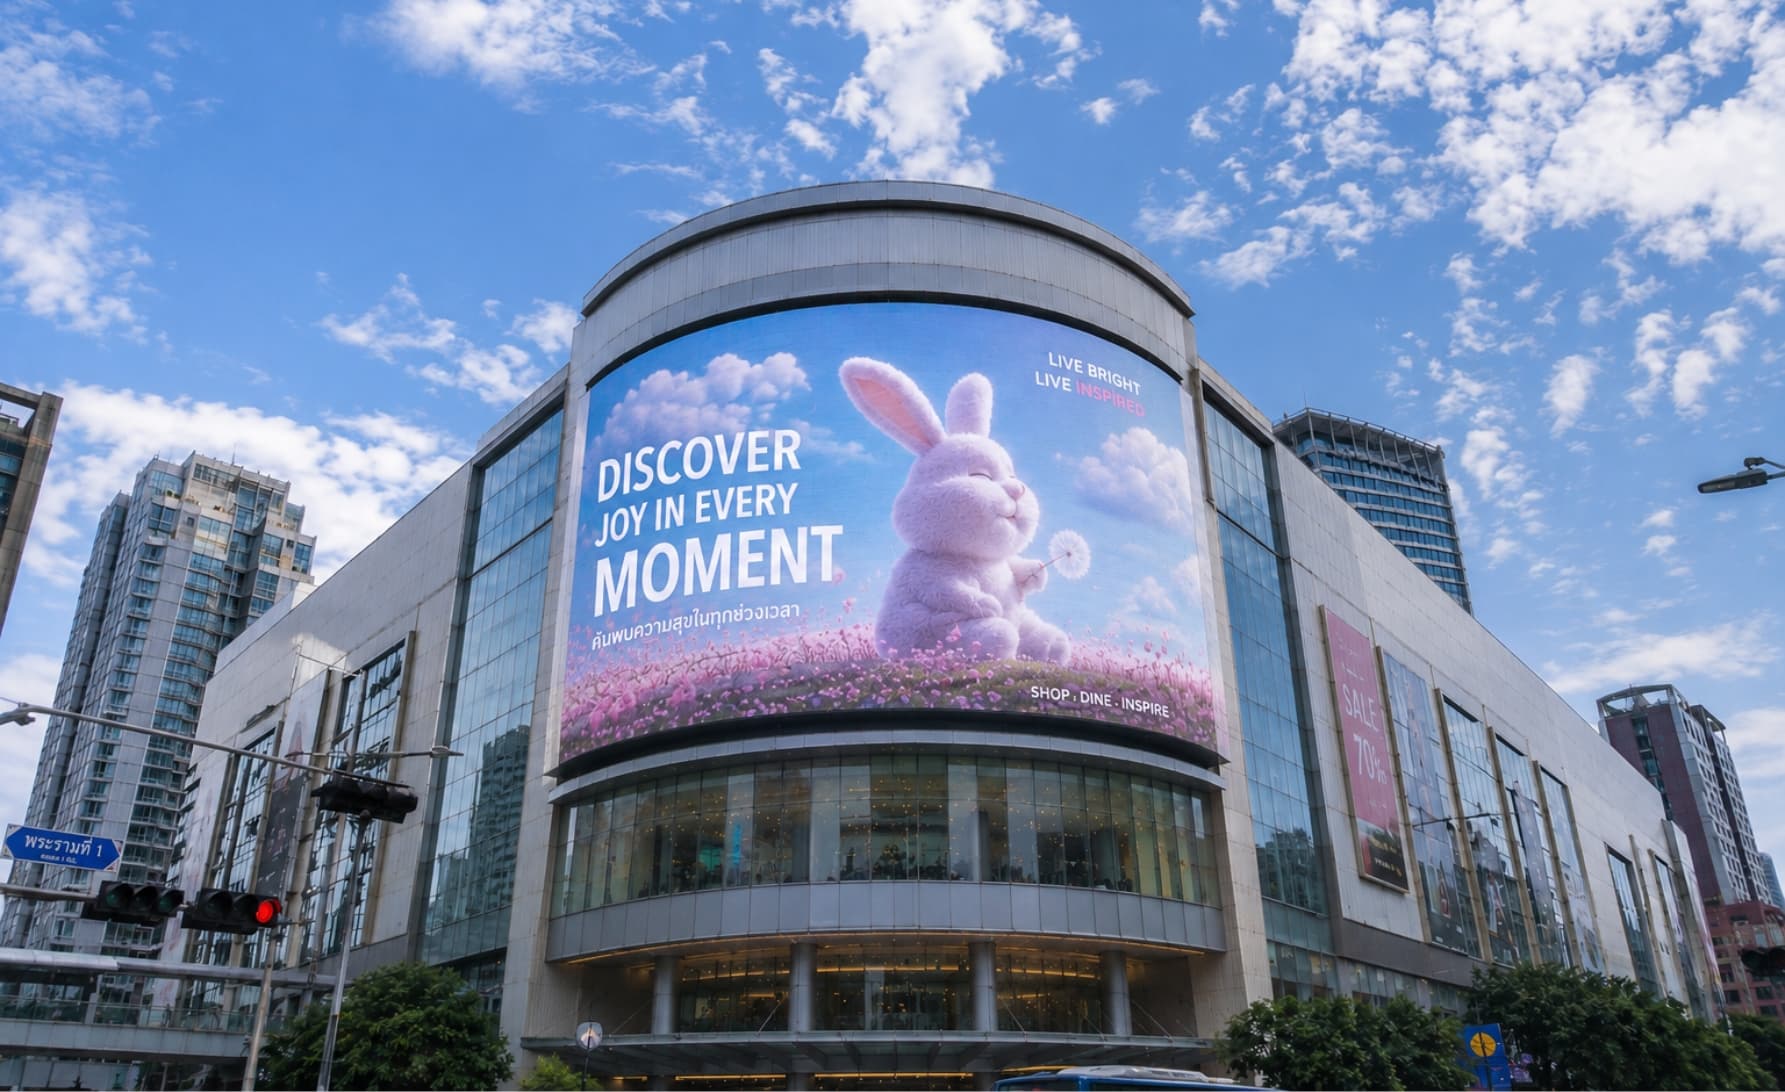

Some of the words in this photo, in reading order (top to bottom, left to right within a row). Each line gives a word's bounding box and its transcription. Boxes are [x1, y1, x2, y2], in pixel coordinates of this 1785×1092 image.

[1035, 371, 1072, 392] LIVE
[1075, 380, 1145, 417] INSPIRED
[1048, 351, 1083, 374] LIVE
[1087, 362, 1141, 395] BRIGHT
[597, 429, 802, 504] DISCOVER
[594, 501, 648, 548] JOY
[655, 494, 685, 531] IN
[695, 482, 799, 524] EVERY
[593, 524, 844, 618] MOMENT
[1031, 685, 1070, 702] SHOP
[1080, 691, 1112, 707] DINE
[1121, 697, 1170, 718] INSPIRE
[1342, 683, 1379, 732] SALE
[24, 834, 93, 857] พระรามที่
[96, 844, 103, 857] 1
